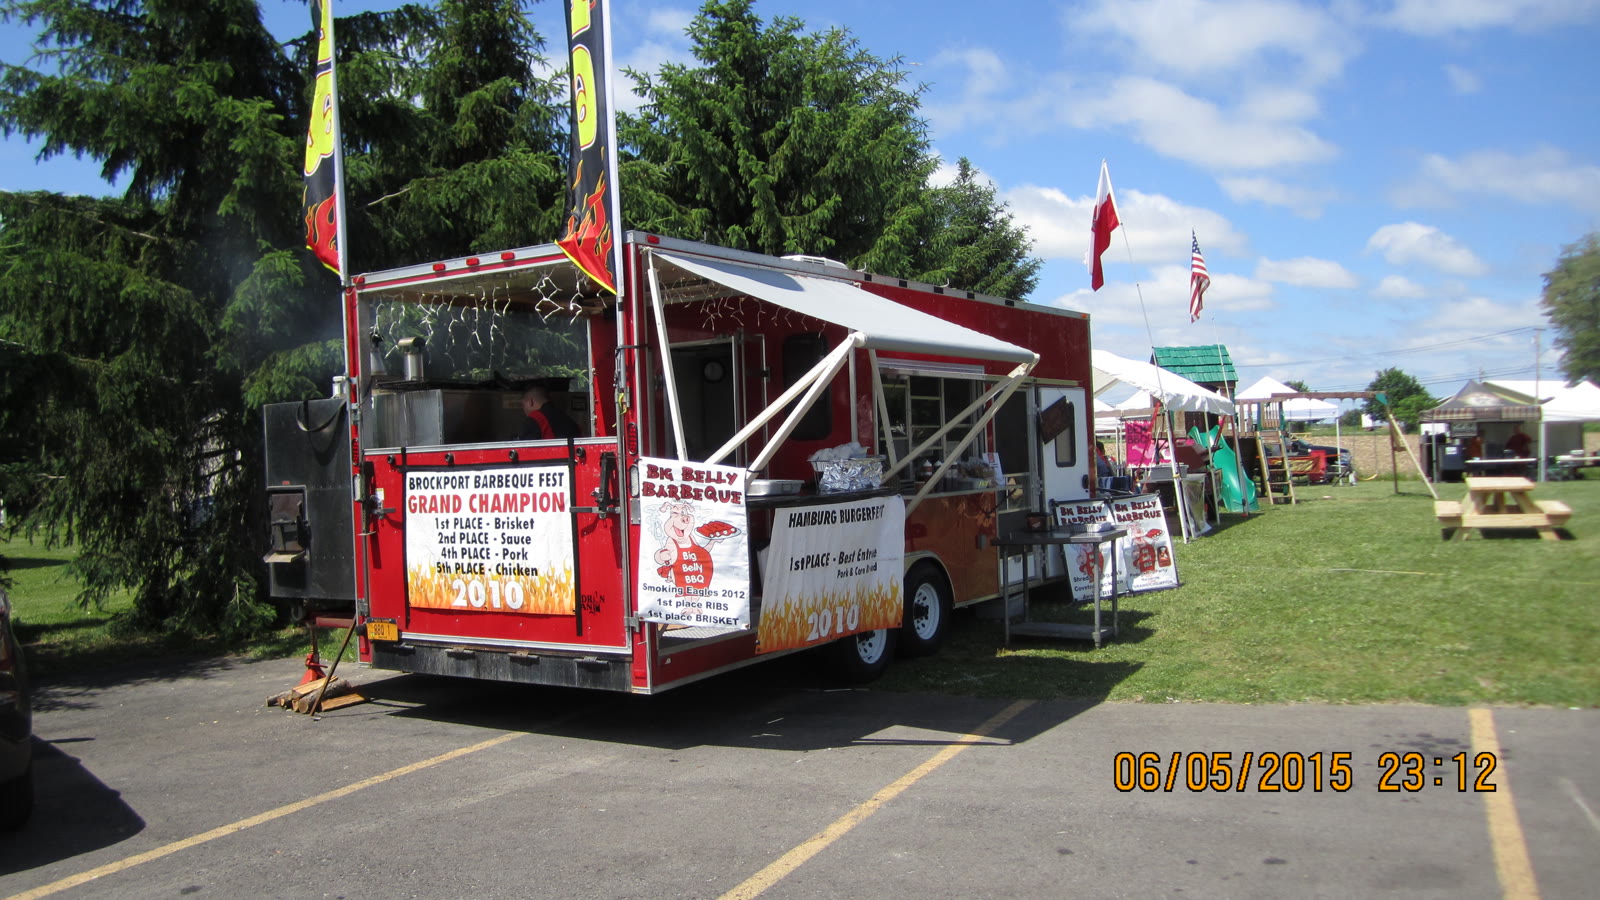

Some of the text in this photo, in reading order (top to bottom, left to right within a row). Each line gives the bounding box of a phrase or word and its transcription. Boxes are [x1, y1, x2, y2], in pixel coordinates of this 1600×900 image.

[409, 472, 565, 490] BROCKPORT BARBEQUE FEST
[647, 464, 738, 486] BIG BELLY
[642, 482, 742, 504] BARBEQUE
[408, 492, 566, 514] GRAND CHAMPION
[1114, 500, 1156, 512] BIG BELLY
[789, 504, 884, 528] HAMBURG BURGERFET
[1060, 505, 1102, 516] BIG BELLY
[1116, 510, 1162, 522] BARBEQUE
[434, 518, 450, 530] 1st
[454, 518, 483, 530] PLACE
[494, 517, 535, 530] Brisket
[438, 532, 456, 545] 2nd
[460, 532, 489, 545] PLACE
[500, 532, 532, 545] Sauce
[441, 547, 458, 560] 4th
[461, 548, 490, 560] PLACE
[502, 549, 528, 561] Pork
[682, 552, 697, 561] Big
[790, 557, 804, 571] 1st
[806, 552, 830, 569] PLACE
[838, 550, 856, 564] Best
[436, 562, 452, 574] 5th
[454, 563, 485, 575] PLACE
[496, 564, 538, 576] Chicken
[681, 564, 702, 573] Belly
[836, 569, 848, 578] Pork
[684, 574, 704, 584] BBQ
[451, 578, 524, 610] 2010
[642, 583, 746, 599] Smoking Eagles 2012
[656, 598, 729, 611] 1st place RIBS
[648, 610, 739, 626] 1st place BRISKET
[806, 604, 860, 641] 2010
